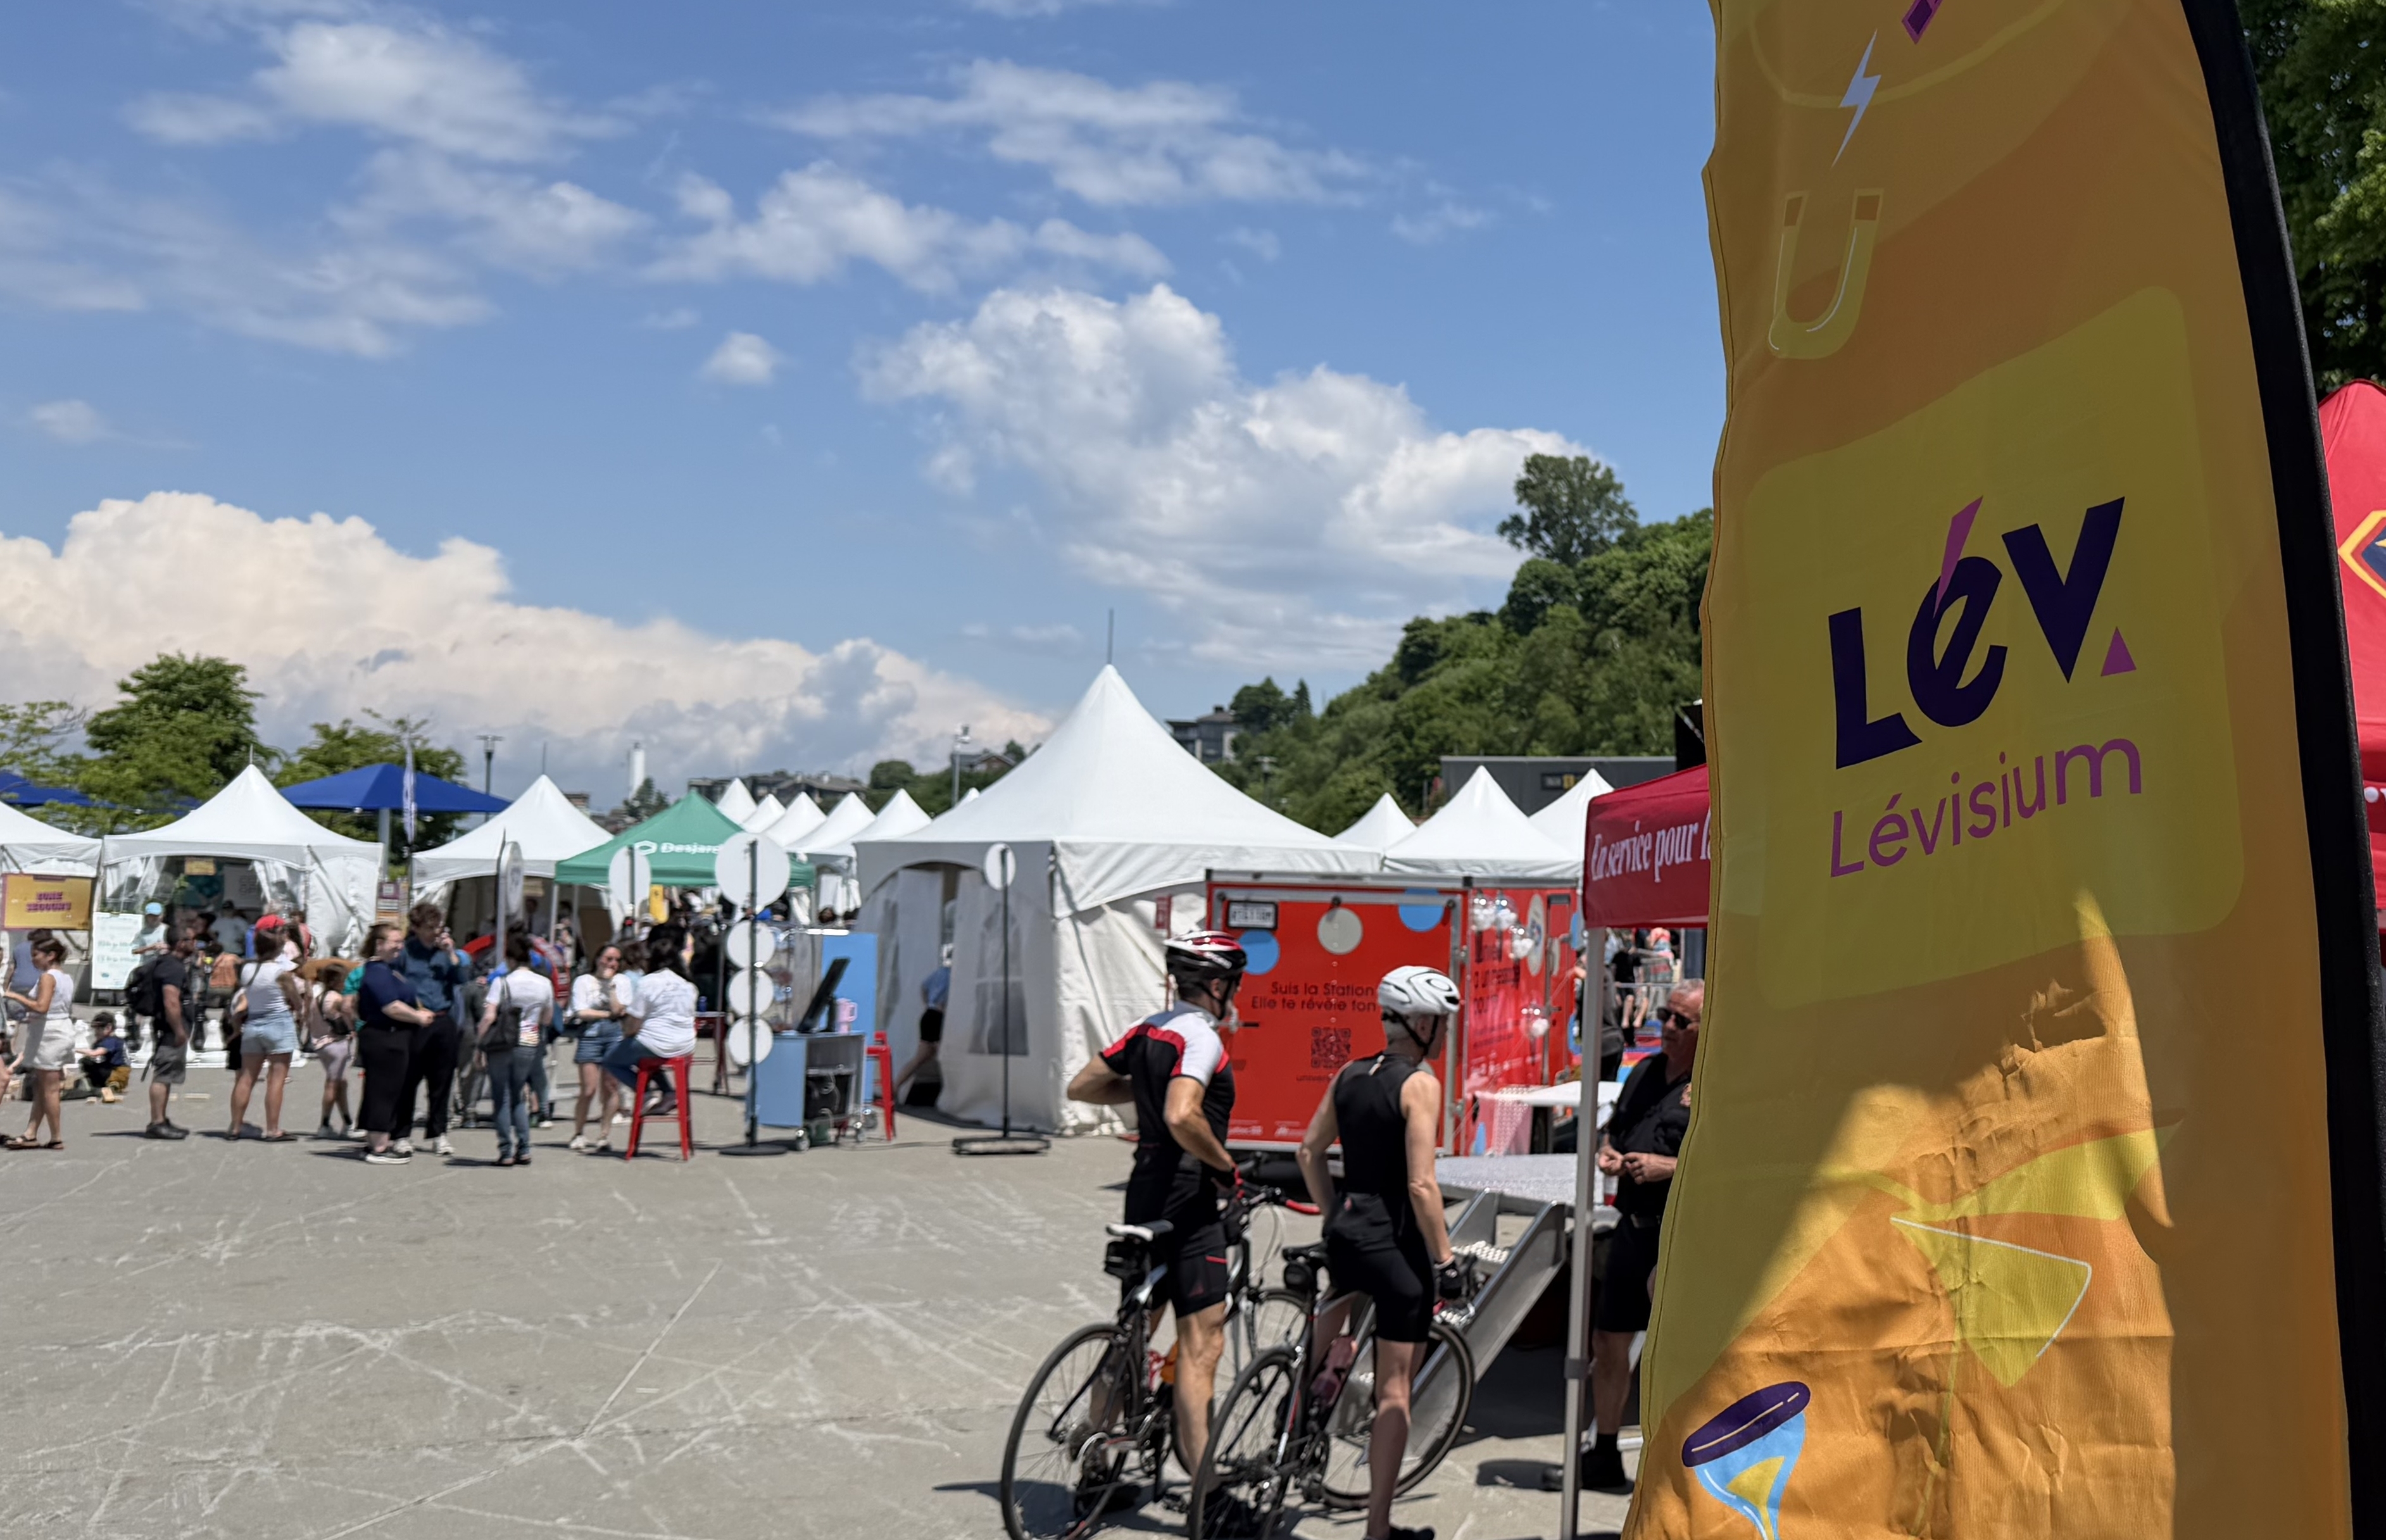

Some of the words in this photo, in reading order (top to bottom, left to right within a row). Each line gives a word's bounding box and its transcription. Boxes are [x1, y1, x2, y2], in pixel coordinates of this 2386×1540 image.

[1830, 737, 2142, 879] Lévisium
[1654, 822, 1699, 883] pour
[1700, 806, 1711, 860] l
[1251, 996, 1277, 1010] Elle
[1282, 997, 1297, 1010] te
[1352, 999, 1377, 1012] ton
[1271, 980, 1299, 995] Suis
[1304, 982, 1319, 996] la
[1323, 983, 1374, 997] Station
